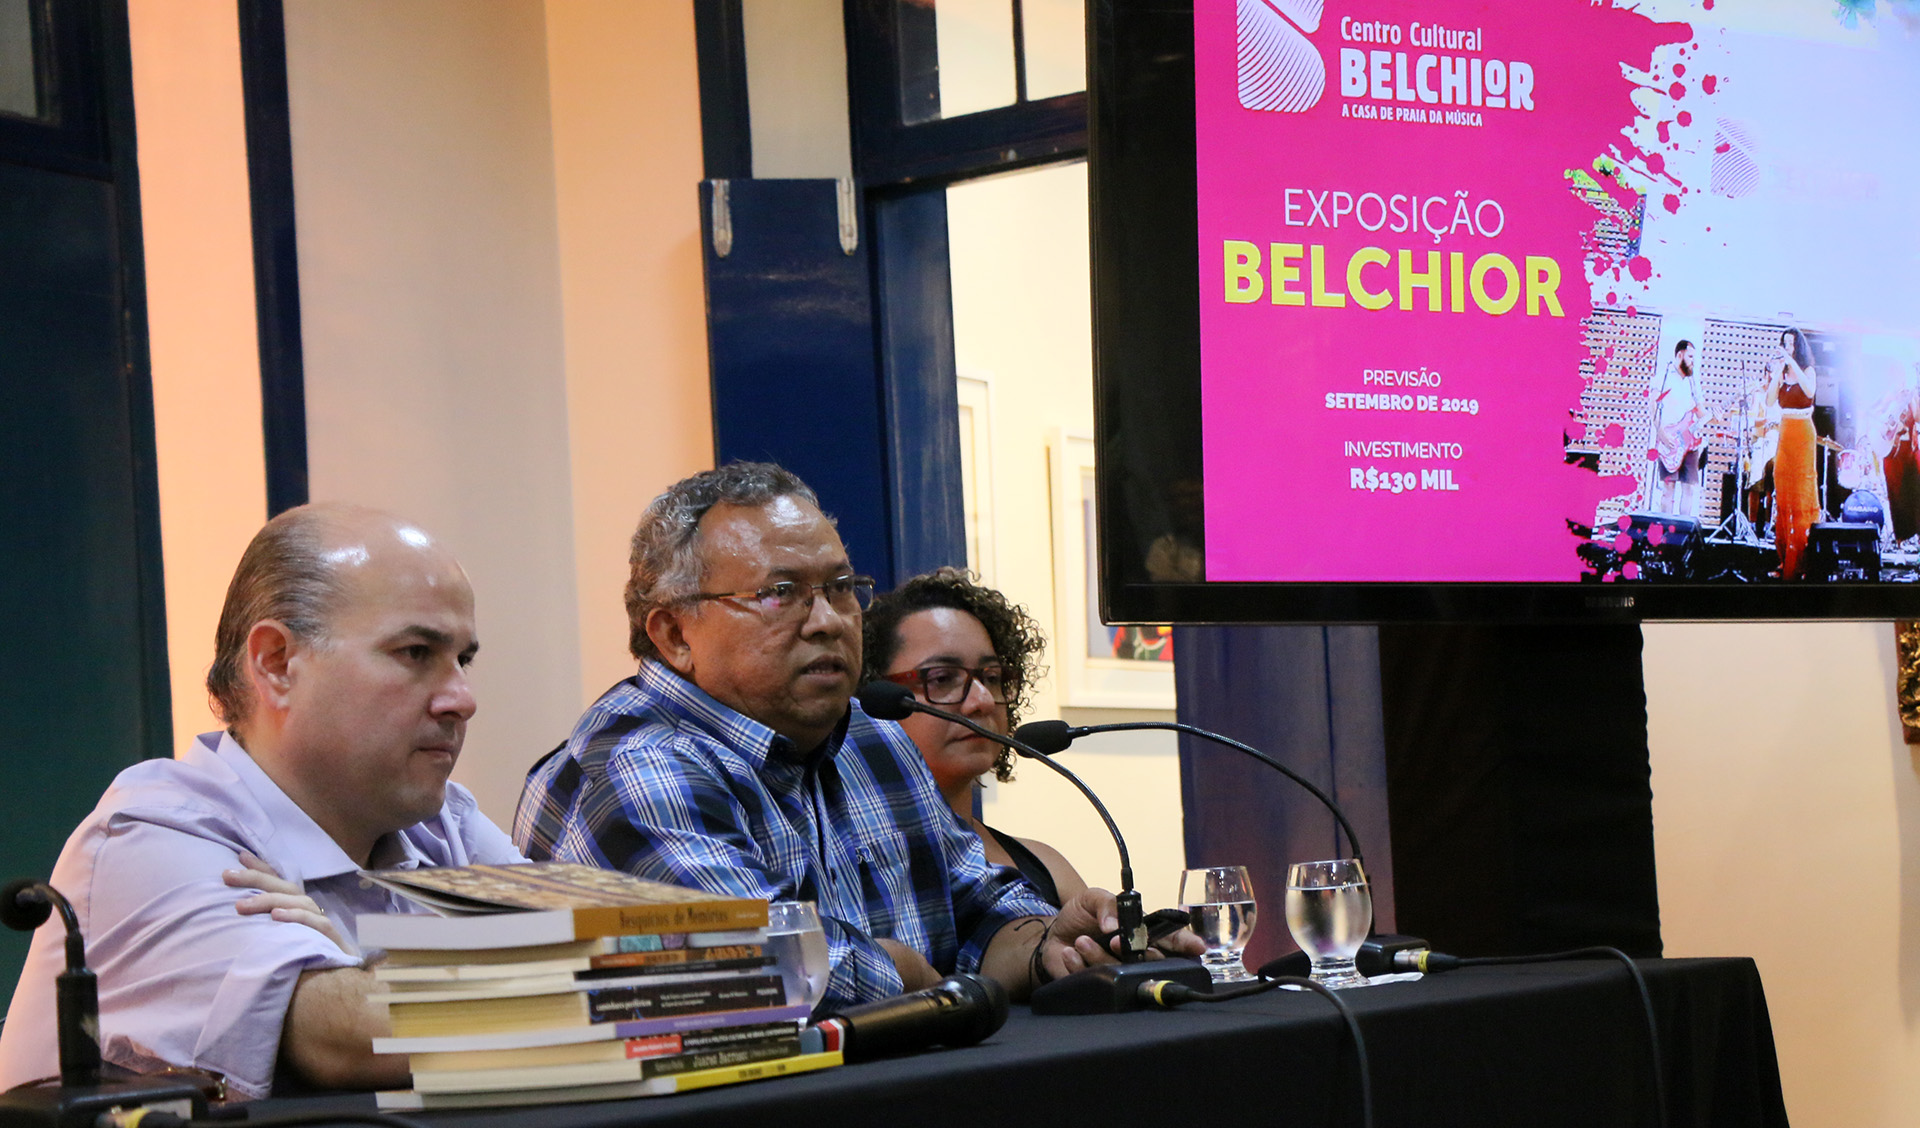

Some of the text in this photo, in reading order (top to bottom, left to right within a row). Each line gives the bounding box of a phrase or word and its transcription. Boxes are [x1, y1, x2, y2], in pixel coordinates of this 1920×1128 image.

[1340, 15, 1482, 51] Centro Cultural
[1340, 48, 1535, 111] BELCHIOR
[1341, 103, 1483, 127] A CASA DE PRAIA DA MÚSICA
[1284, 188, 1505, 244] EXPOSIÇÃO
[1223, 239, 1565, 318] BELCHIOR
[1363, 366, 1442, 388] PREVISÃO
[1325, 392, 1480, 415] SETEMBRO DE 2019
[1344, 441, 1463, 459] INVESTIMENTO
[1350, 466, 1460, 494] R$130 MIL
